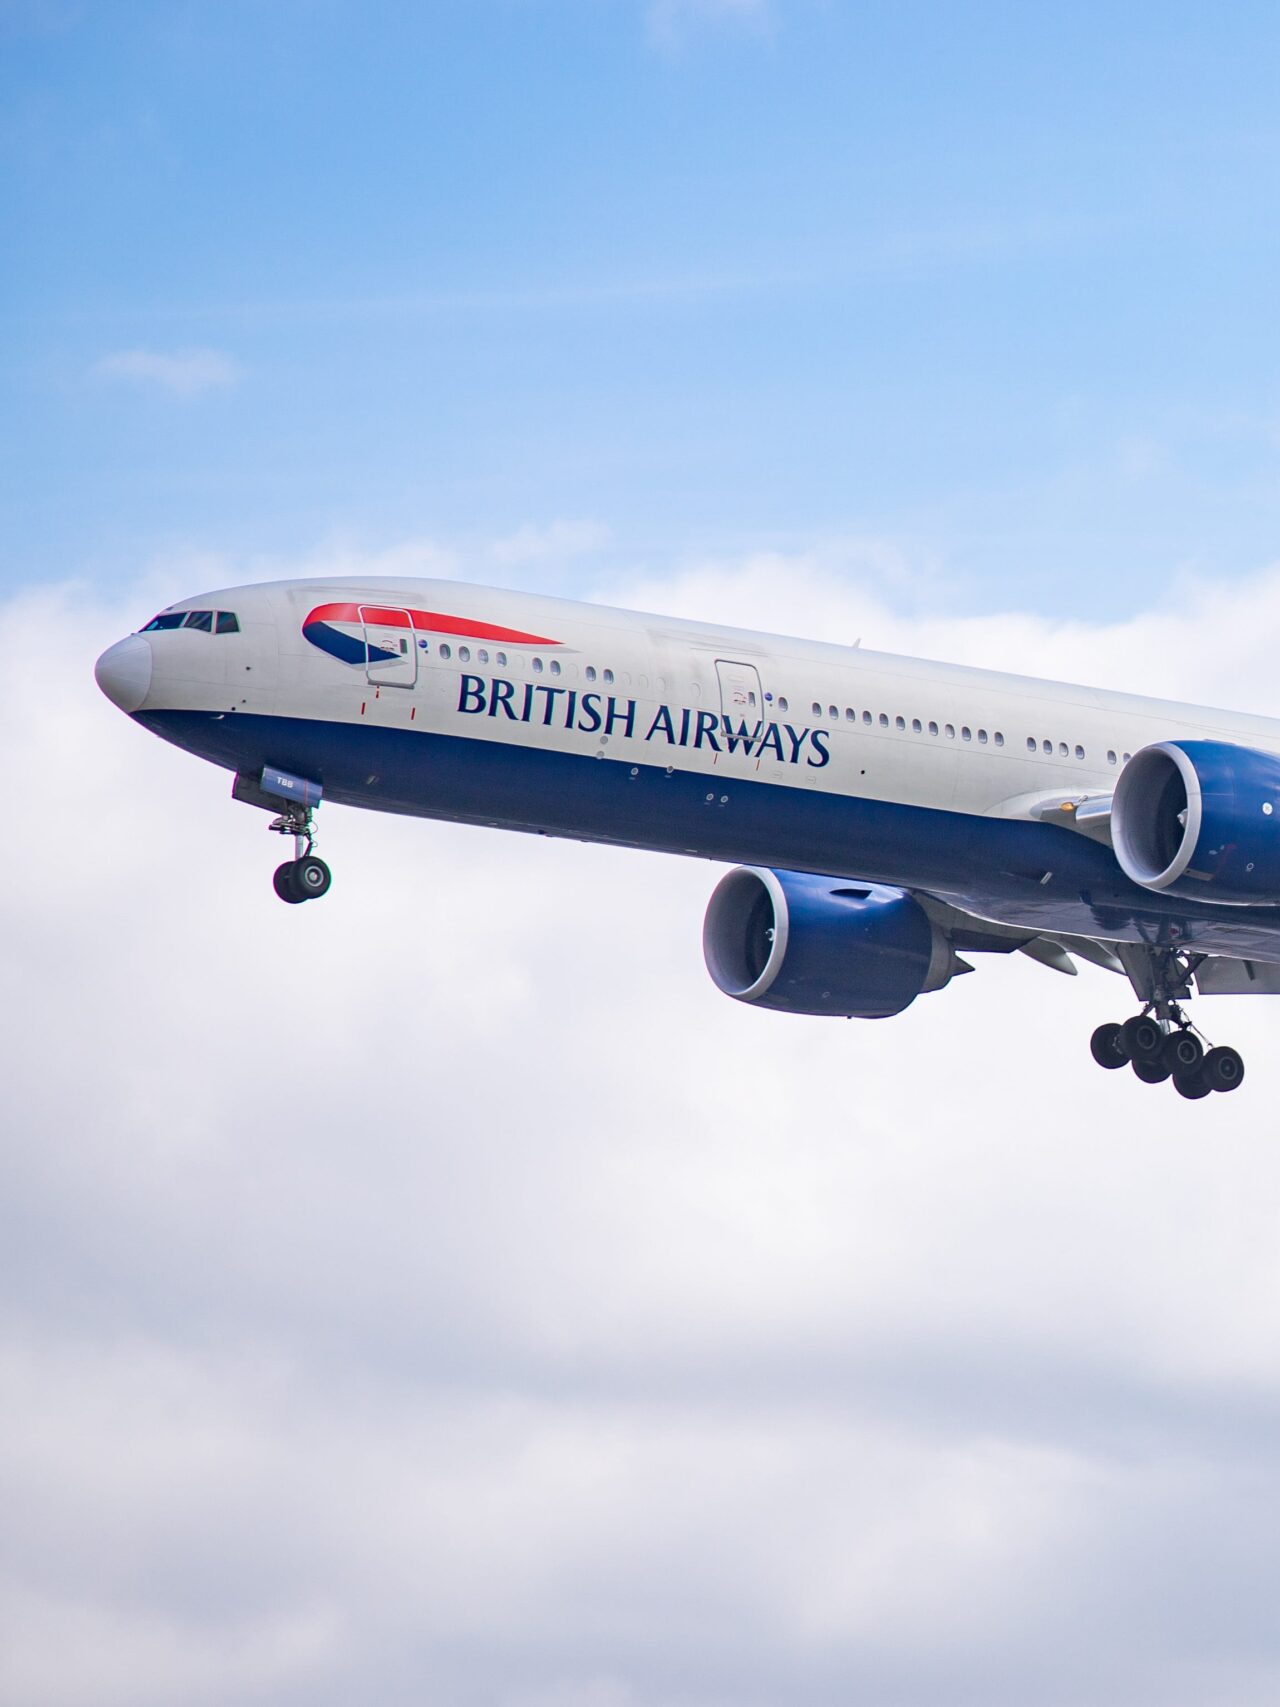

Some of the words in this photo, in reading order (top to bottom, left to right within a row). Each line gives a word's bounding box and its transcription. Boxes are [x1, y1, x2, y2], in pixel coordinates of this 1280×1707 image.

[457, 673, 636, 738] BRITISH
[645, 704, 830, 768] AIRWAYS
[276, 776, 294, 788] TBB
